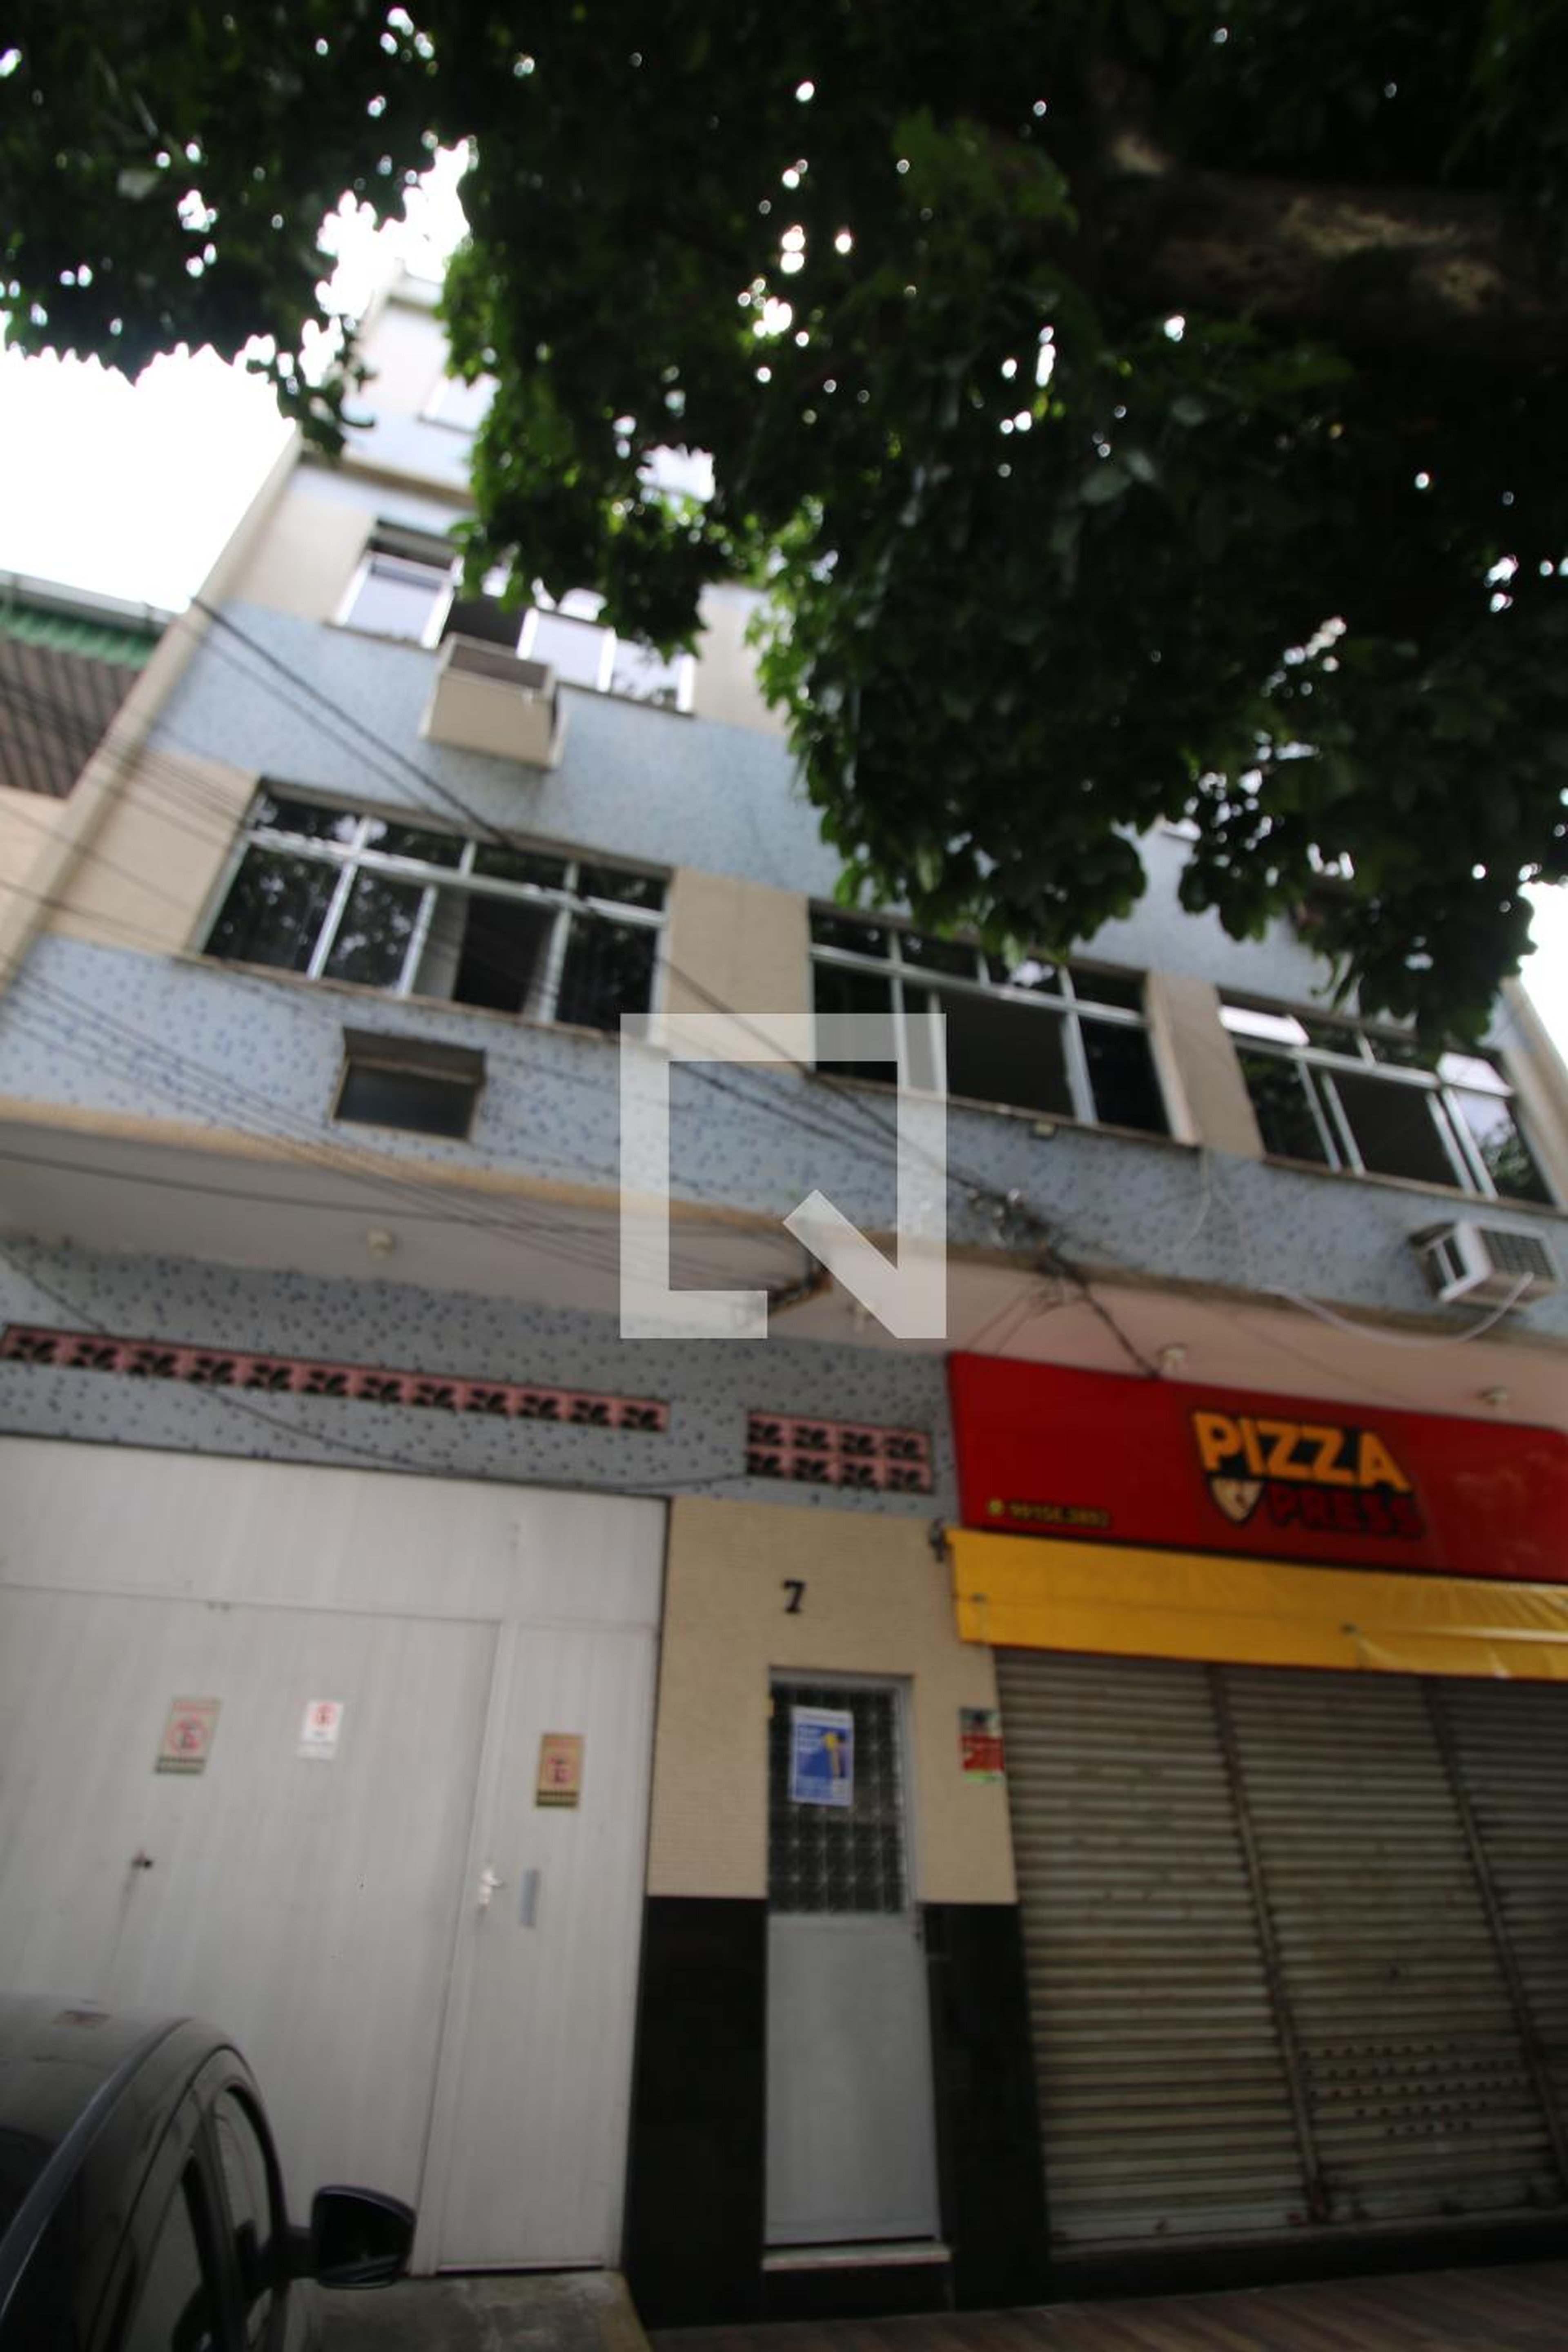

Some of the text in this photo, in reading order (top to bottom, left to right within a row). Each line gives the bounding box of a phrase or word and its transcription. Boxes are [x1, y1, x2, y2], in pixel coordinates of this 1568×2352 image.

[1193, 1411, 1414, 1493] PIZZA
[1268, 1481, 1425, 1539] PRESS
[783, 1579, 806, 1615] 7
